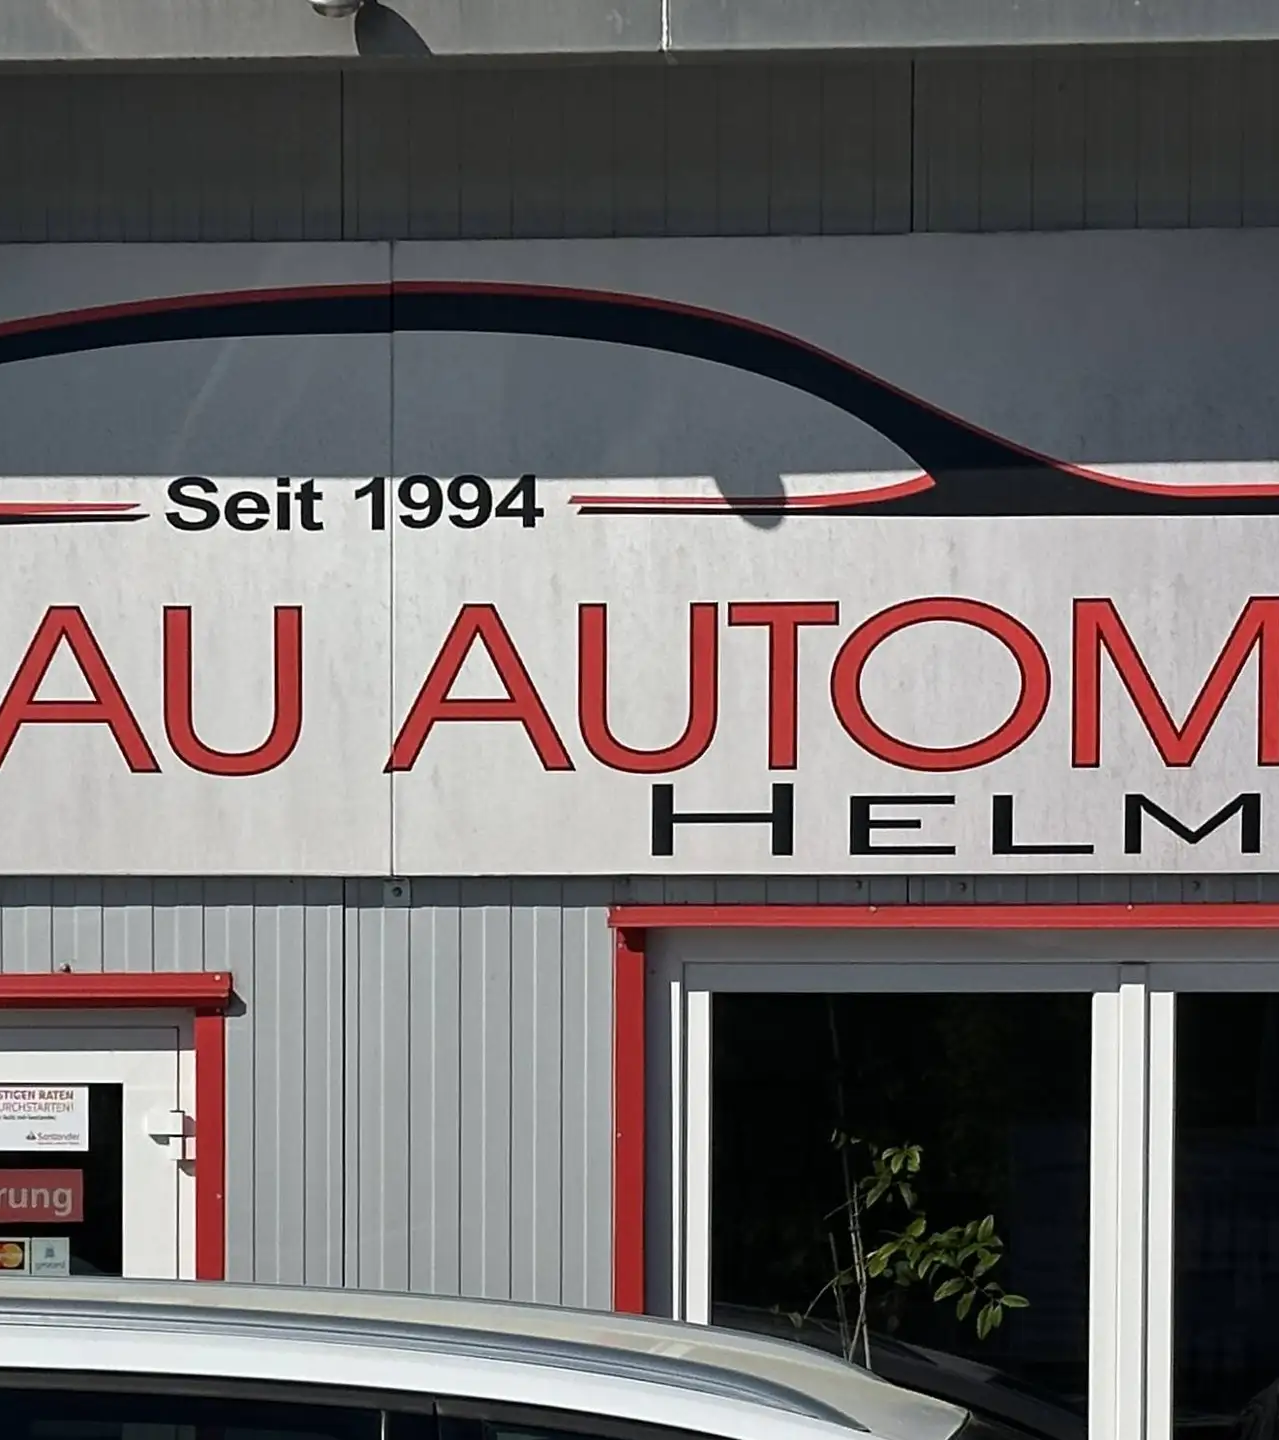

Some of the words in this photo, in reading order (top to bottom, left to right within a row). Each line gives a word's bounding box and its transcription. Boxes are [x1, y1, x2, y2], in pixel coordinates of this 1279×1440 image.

[166, 477, 323, 530] Seit
[356, 477, 544, 530] 1994
[38, 1089, 74, 1101] RATEN
